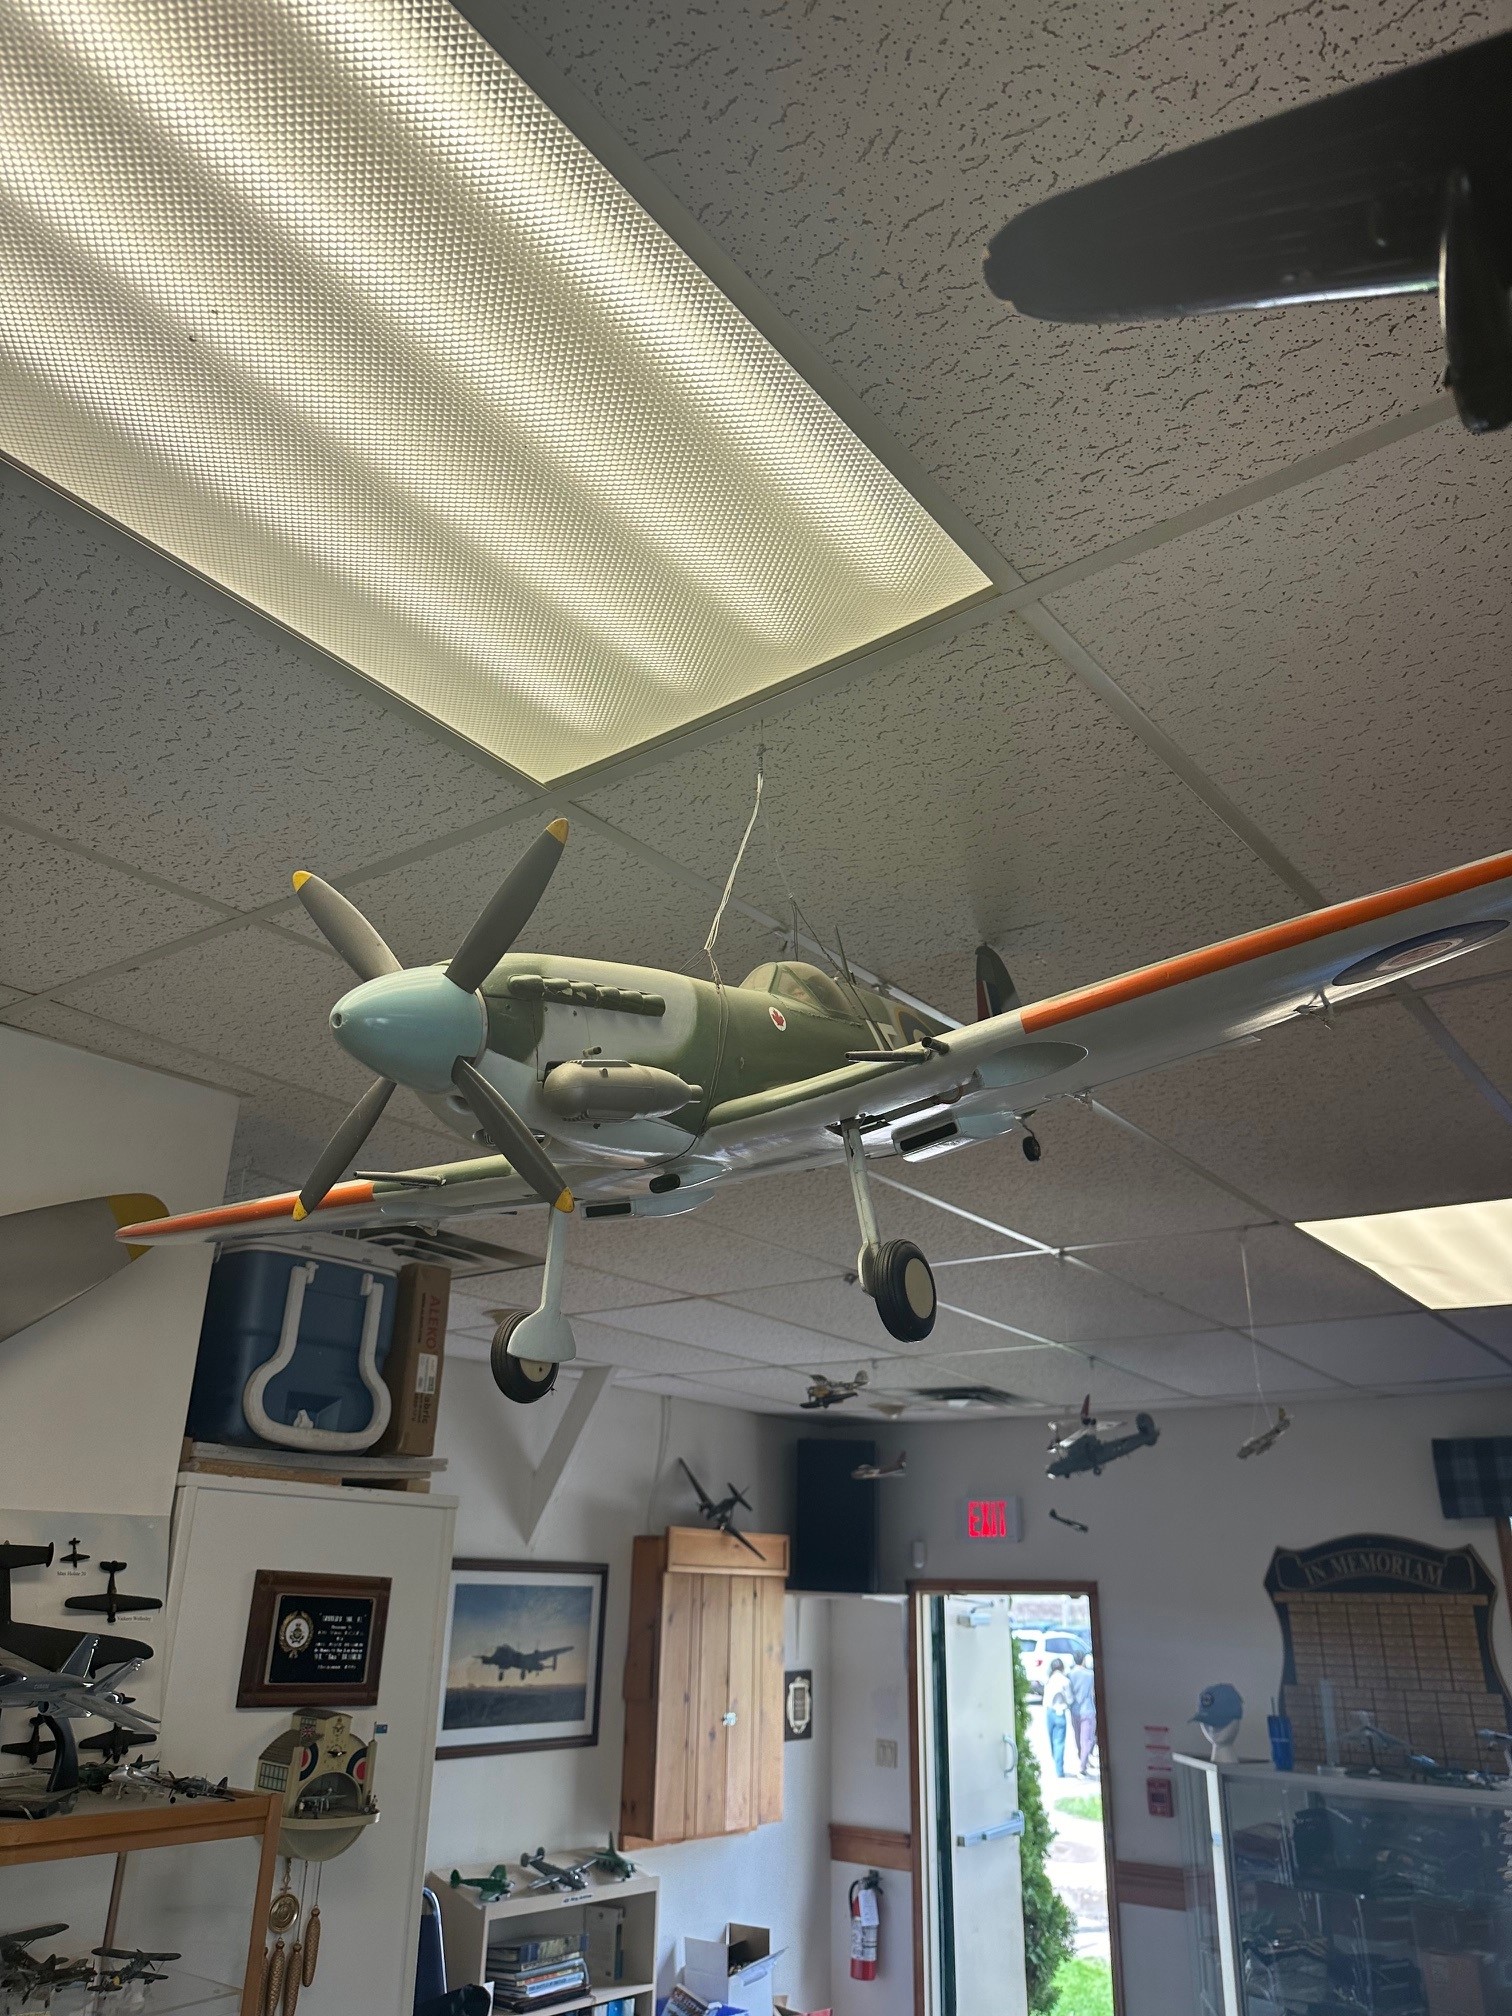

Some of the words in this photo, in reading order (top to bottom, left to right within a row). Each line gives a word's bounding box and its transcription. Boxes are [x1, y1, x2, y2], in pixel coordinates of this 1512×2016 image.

[426, 1294, 441, 1349] ALEKO
[968, 1500, 1007, 1537] EXIT
[1304, 1565, 1327, 1585] IN
[1330, 1552, 1443, 1586] MEMORIAM
